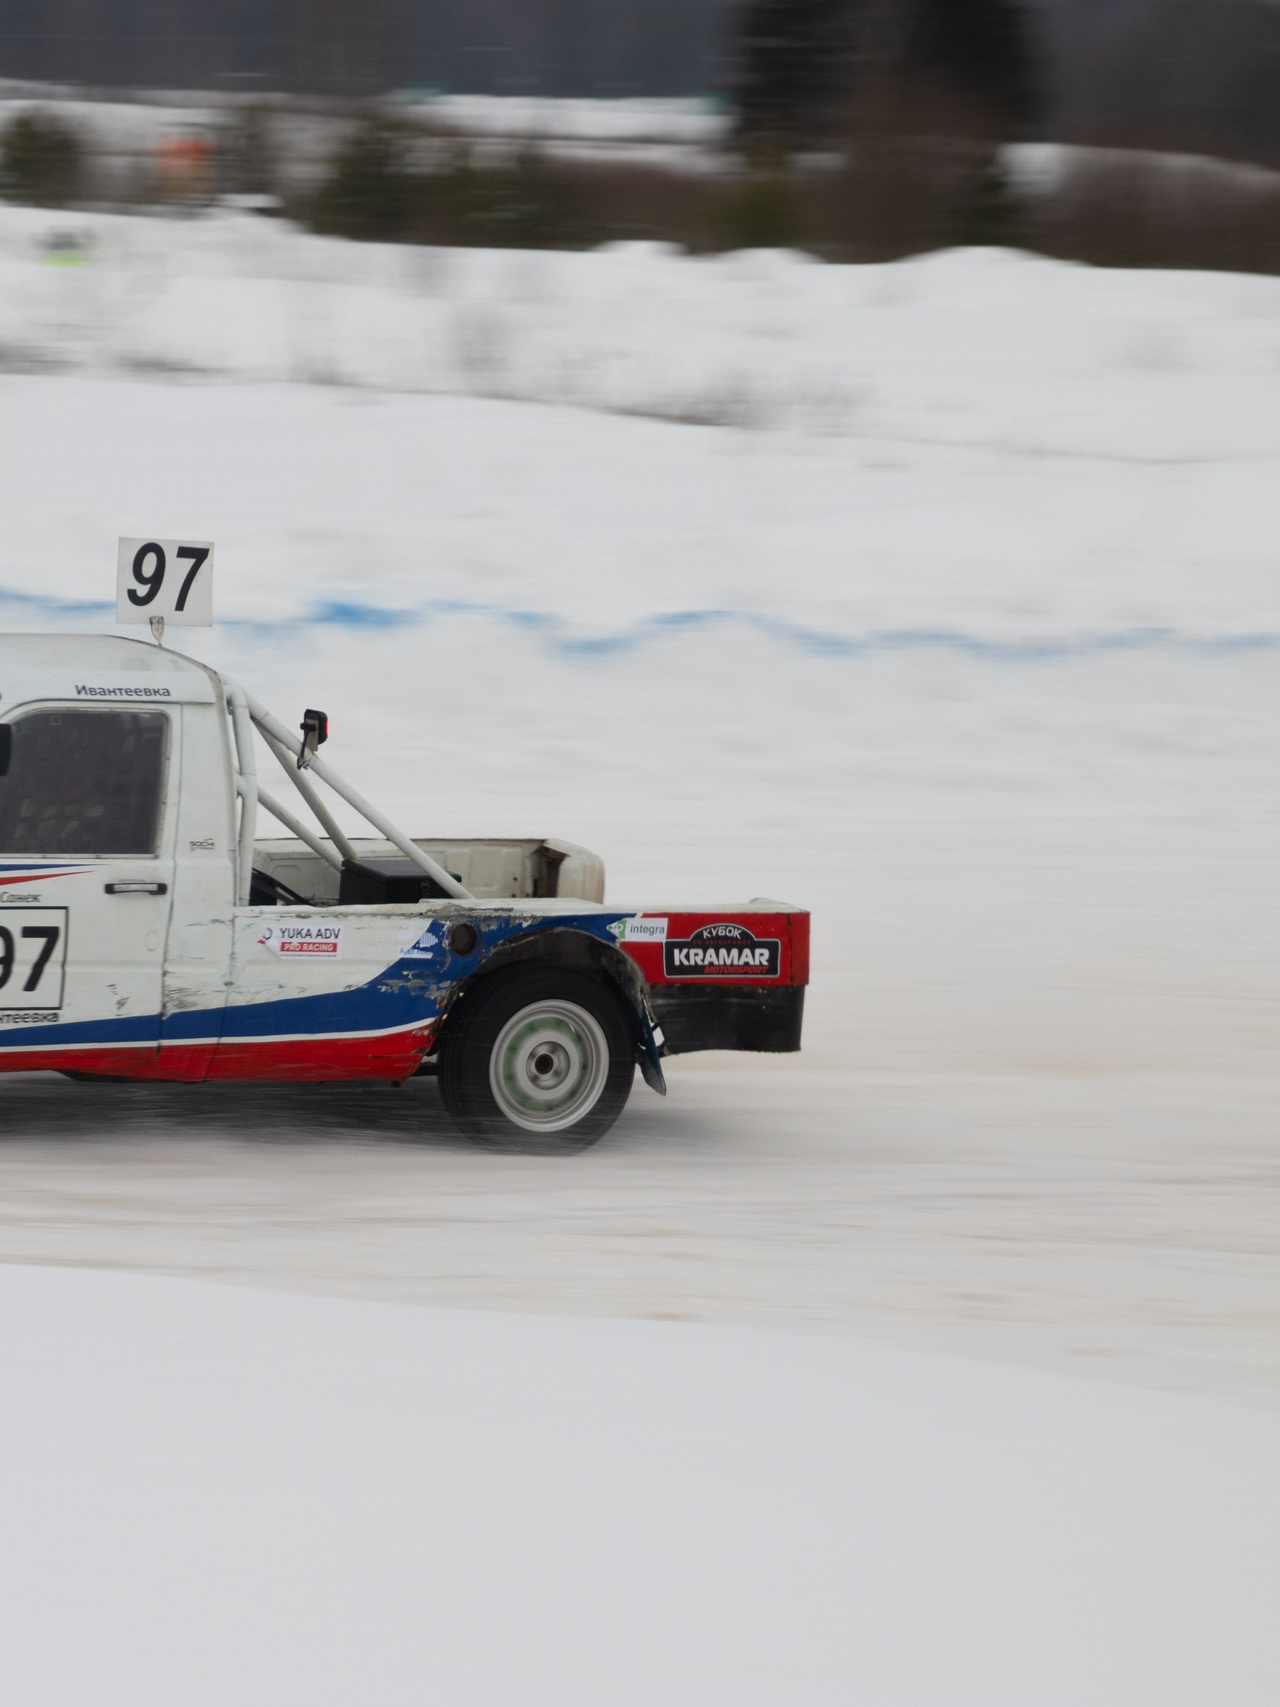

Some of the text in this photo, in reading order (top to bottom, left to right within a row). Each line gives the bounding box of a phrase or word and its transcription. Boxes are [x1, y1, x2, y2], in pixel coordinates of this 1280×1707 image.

[126, 541, 210, 612] 97
[74, 684, 171, 697] Ивантеевка
[280, 927, 341, 939] YUKA ADV
[630, 923, 665, 936] integra
[702, 926, 742, 939] КУБОК
[283, 943, 334, 952] PRO RACING
[673, 947, 770, 966] KRAMAR
[703, 965, 769, 974] MOTORSPORT
